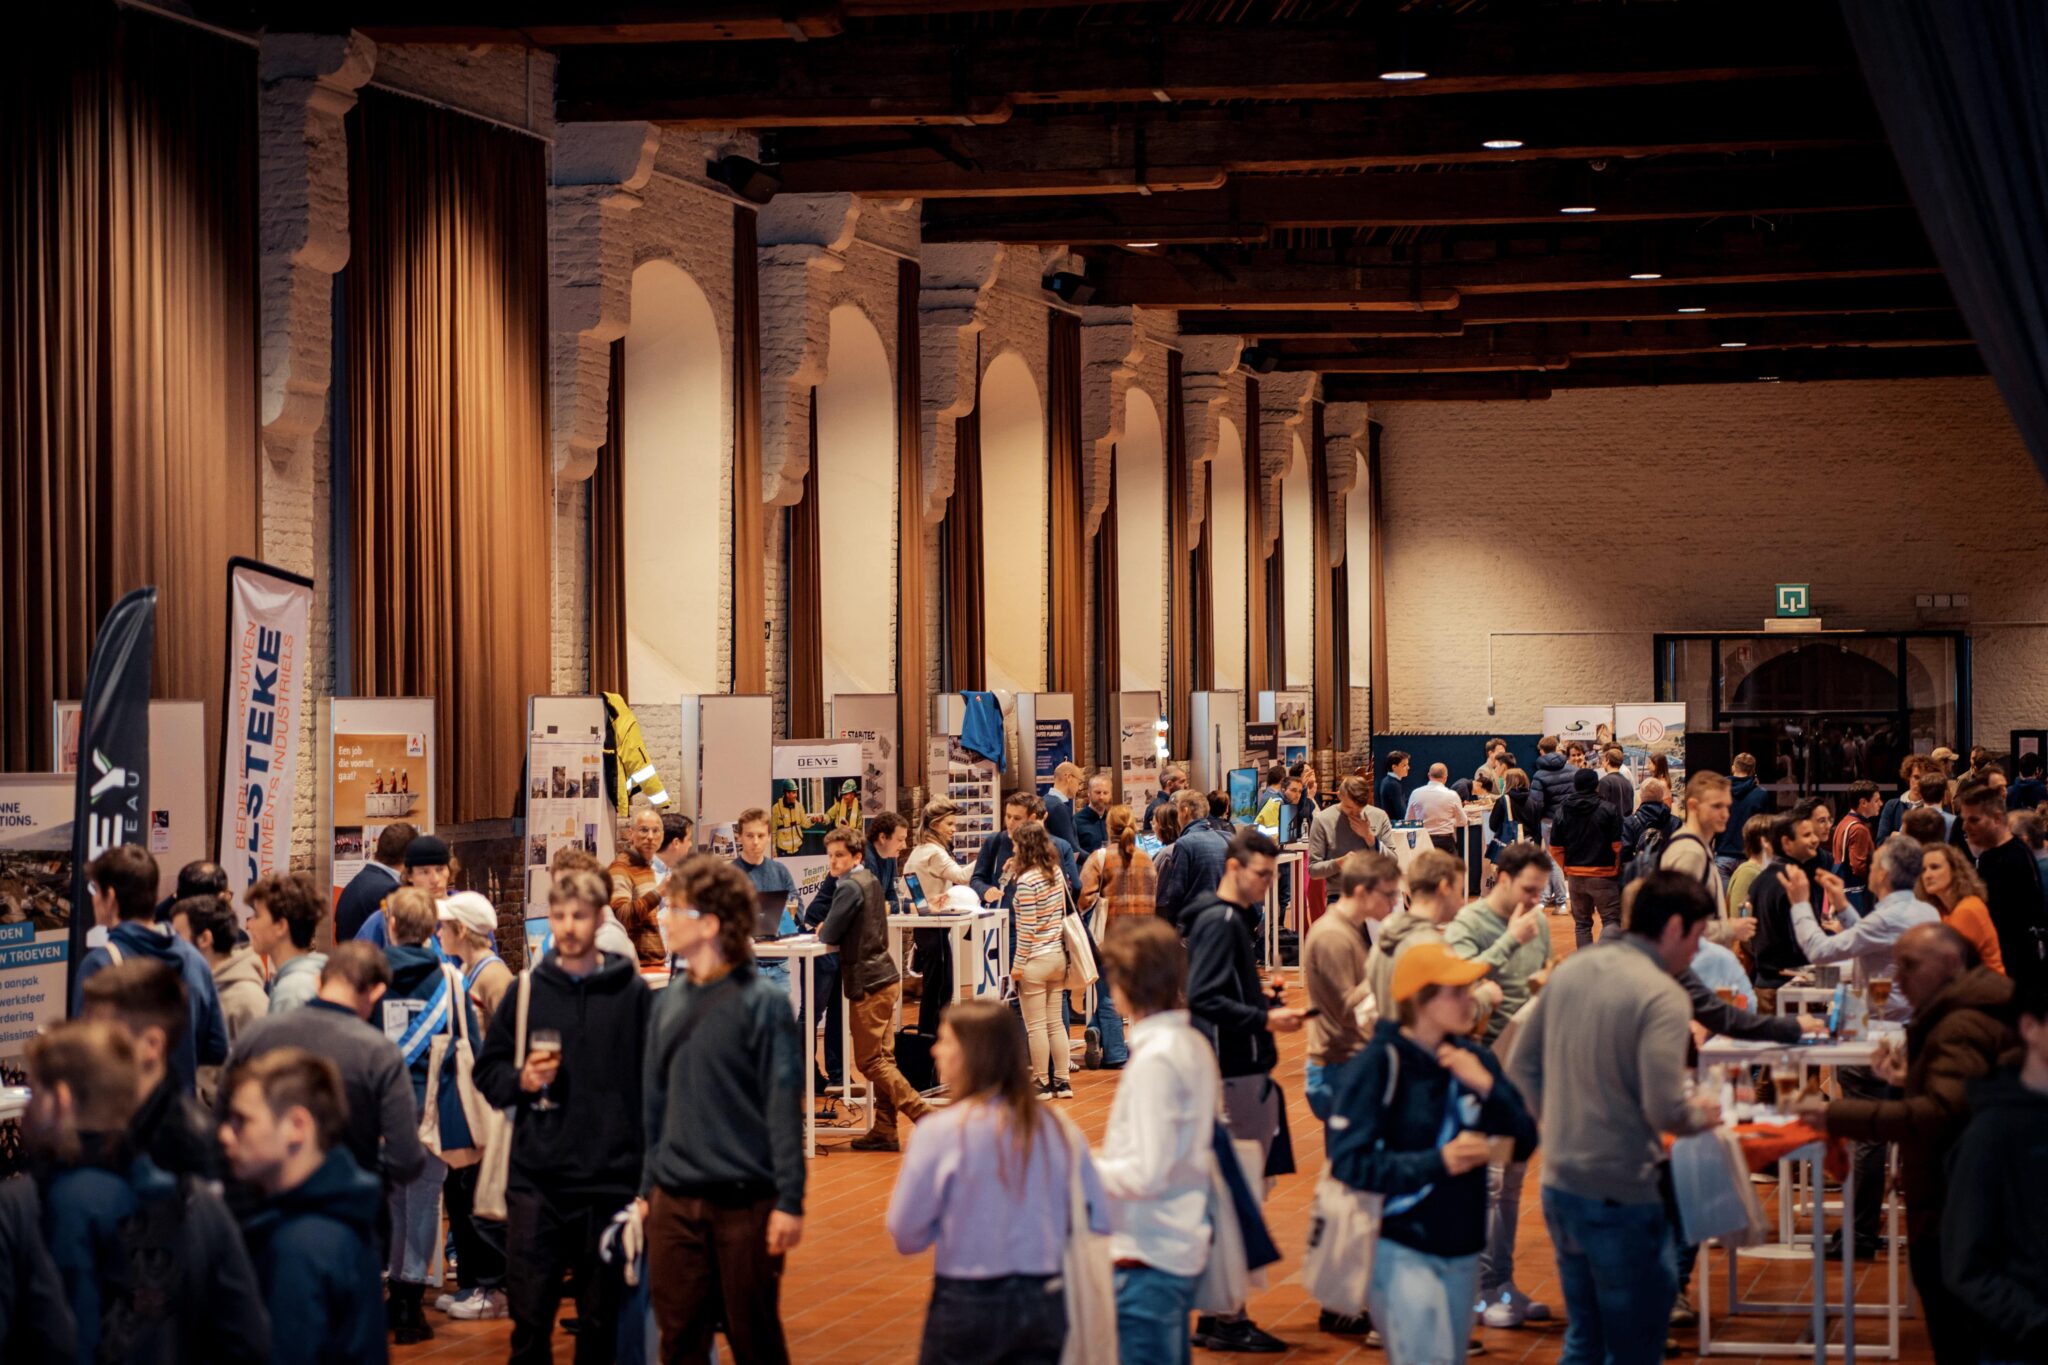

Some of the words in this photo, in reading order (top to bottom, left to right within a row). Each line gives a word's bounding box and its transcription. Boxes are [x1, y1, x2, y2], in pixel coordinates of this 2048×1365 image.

[262, 776, 280, 881] ATIMENTS
[273, 633, 294, 770] INDUSTRIELS
[338, 746, 351, 756] Een
[352, 746, 363, 758] job
[338, 759, 350, 768] die
[351, 758, 374, 768] vooruit
[797, 757, 838, 767] DENYS
[126, 772, 140, 845] EAU
[803, 865, 826, 877] Team
[802, 875, 820, 886] voor
[10, 946, 61, 963] TROEVEN
[4, 976, 39, 989] aanpak
